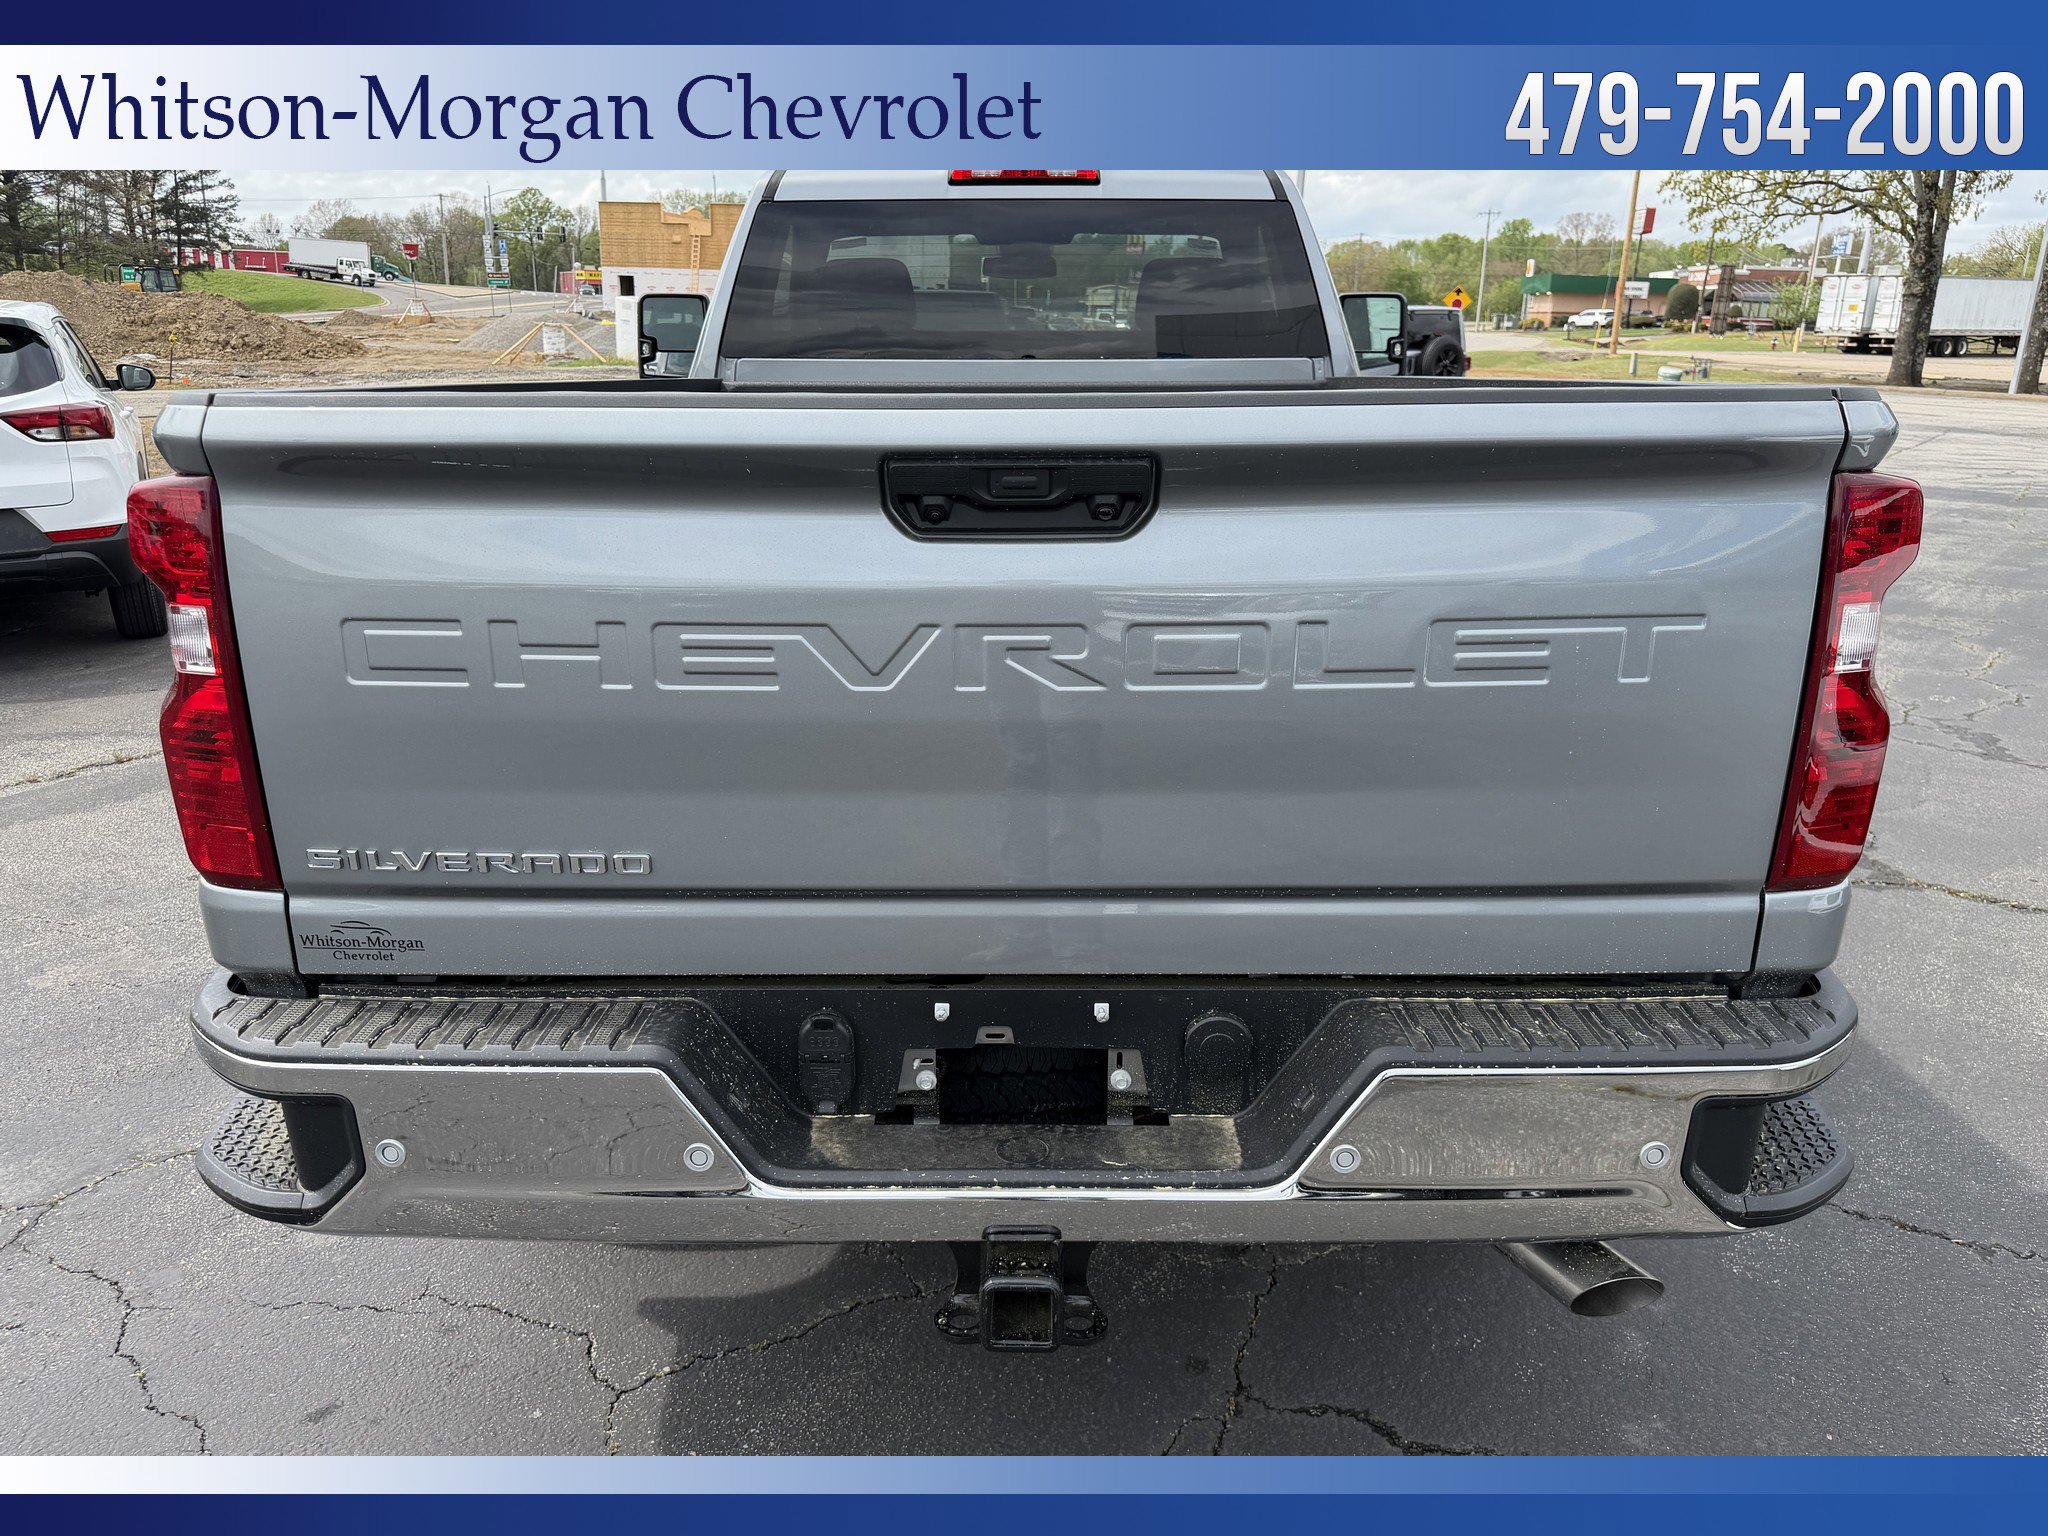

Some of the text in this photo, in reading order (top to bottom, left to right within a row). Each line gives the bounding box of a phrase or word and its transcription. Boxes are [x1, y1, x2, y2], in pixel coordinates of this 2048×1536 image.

[339, 613, 1708, 693] CHEVROLET
[305, 847, 653, 876] SILVERADO
[299, 933, 425, 954] Whitson-Morgan
[332, 949, 396, 962] Chevrolet
